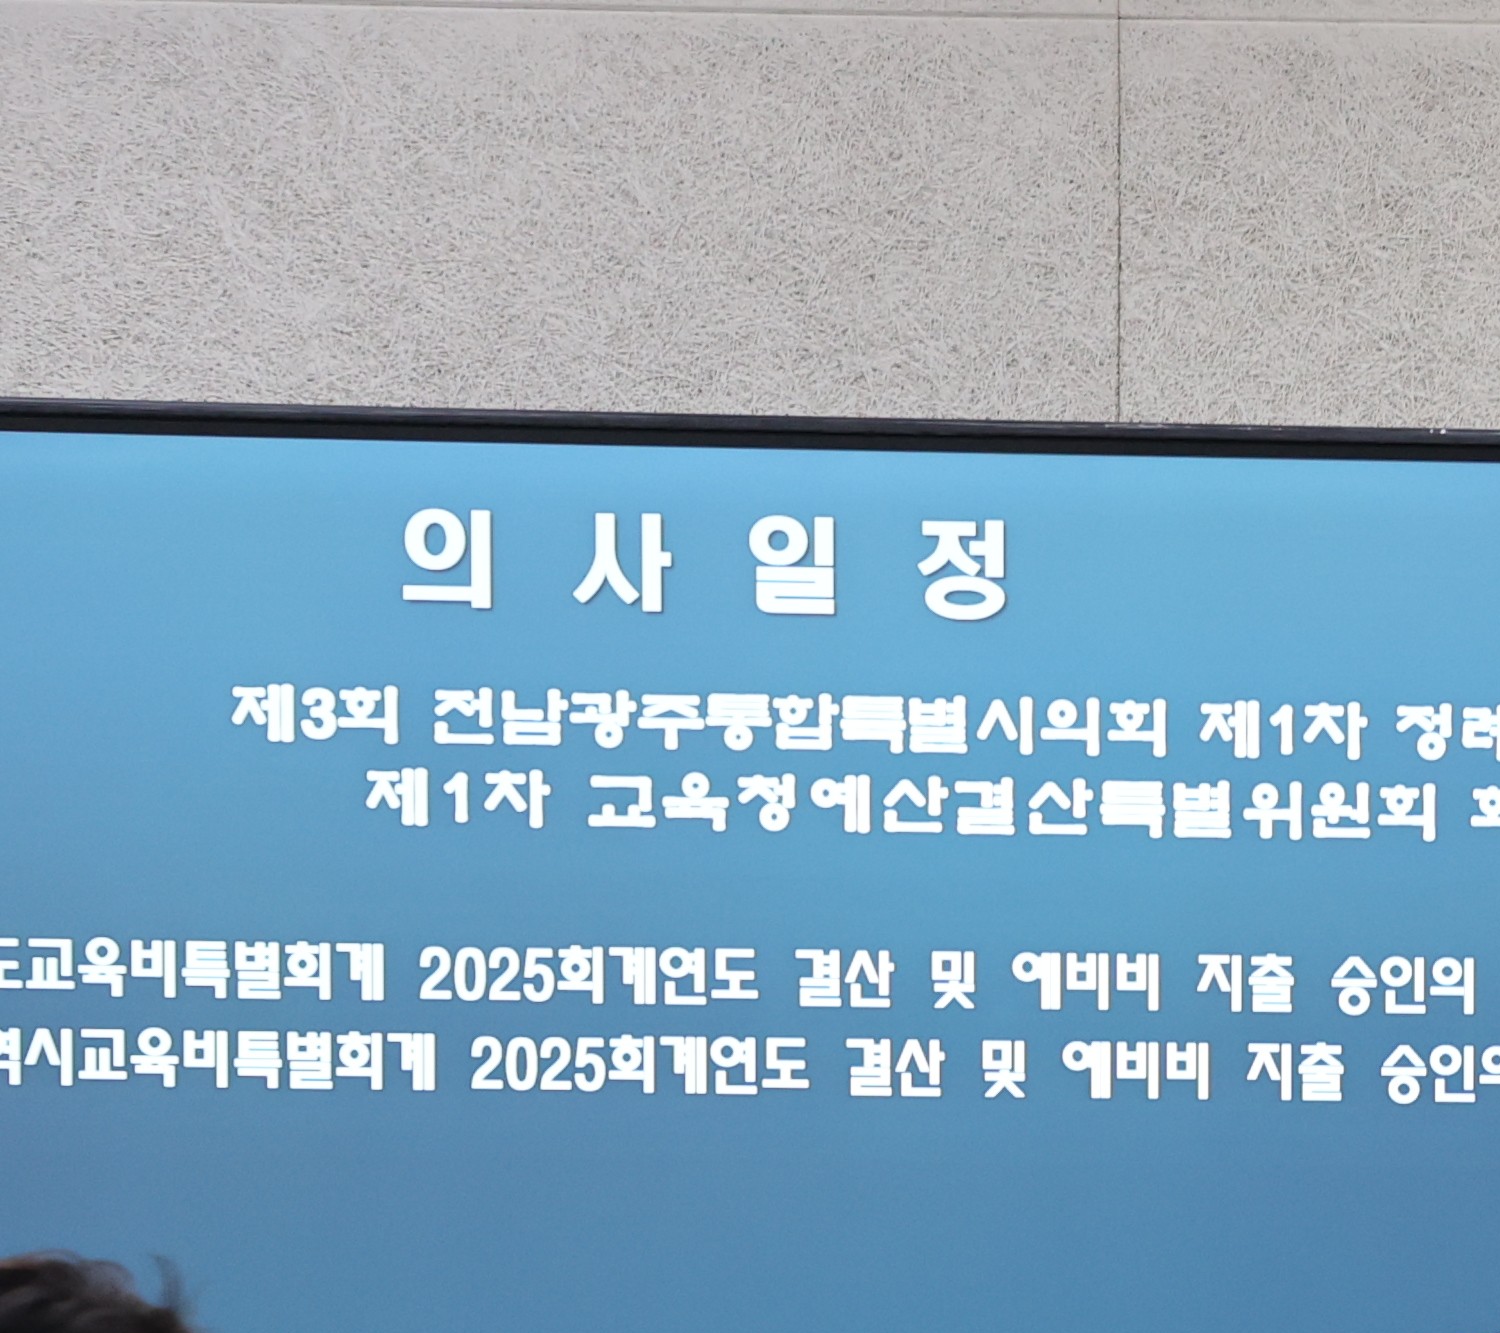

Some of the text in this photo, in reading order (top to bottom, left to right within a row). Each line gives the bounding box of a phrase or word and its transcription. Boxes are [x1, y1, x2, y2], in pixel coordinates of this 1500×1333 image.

[231, 684, 400, 747] 제3회
[432, 687, 1169, 759] 전남광주통합특별시의회
[1200, 700, 1370, 762] 제1차
[366, 767, 553, 831] 제1차
[588, 772, 1438, 844] 교육청예산결산특별위원회
[419, 945, 761, 1007] 2025회계연도
[795, 949, 897, 1010] 결산
[931, 951, 977, 1011] 및
[1012, 952, 1161, 1013] 예비비
[1197, 953, 1297, 1015] 지출
[1331, 956, 1476, 1018] 승인의
[471, 1034, 812, 1097] 2025회계연도
[846, 1038, 947, 1099] 결산
[982, 1040, 1028, 1100] 및
[1062, 1041, 1211, 1102] 예비비
[1247, 1042, 1346, 1103] 지출
